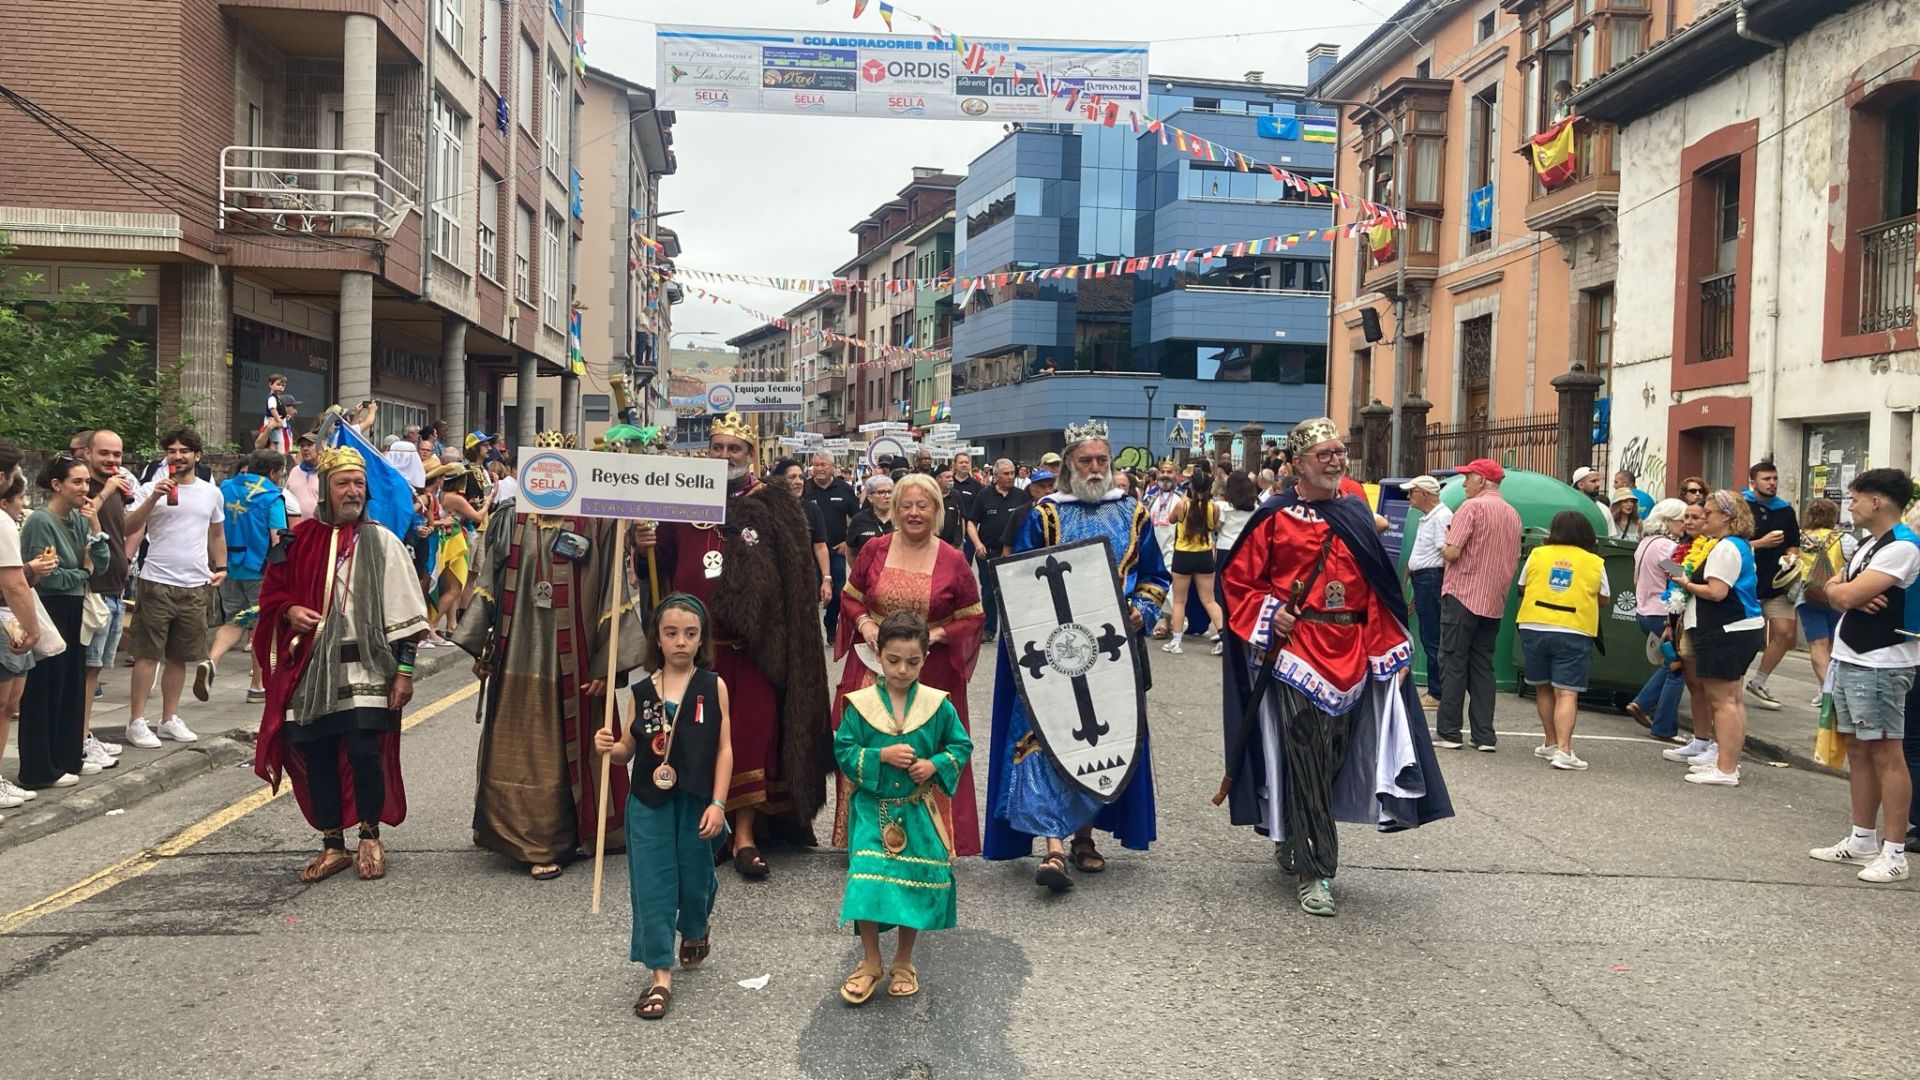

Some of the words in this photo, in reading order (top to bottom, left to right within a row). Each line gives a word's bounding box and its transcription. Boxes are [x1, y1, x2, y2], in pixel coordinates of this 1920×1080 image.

[803, 36, 922, 49] COLABORADORES
[887, 61, 950, 78] ORDIS
[988, 78, 1004, 95] la
[695, 91, 728, 100] SELLA
[795, 94, 825, 104] SELLA
[889, 96, 925, 107] SELLA
[735, 384, 764, 395] Equipo
[754, 395, 782, 404] Salida
[530, 478, 567, 490] SELLA
[591, 468, 640, 487] Reyes
[645, 472, 670, 487] del
[675, 473, 715, 490] Sella
